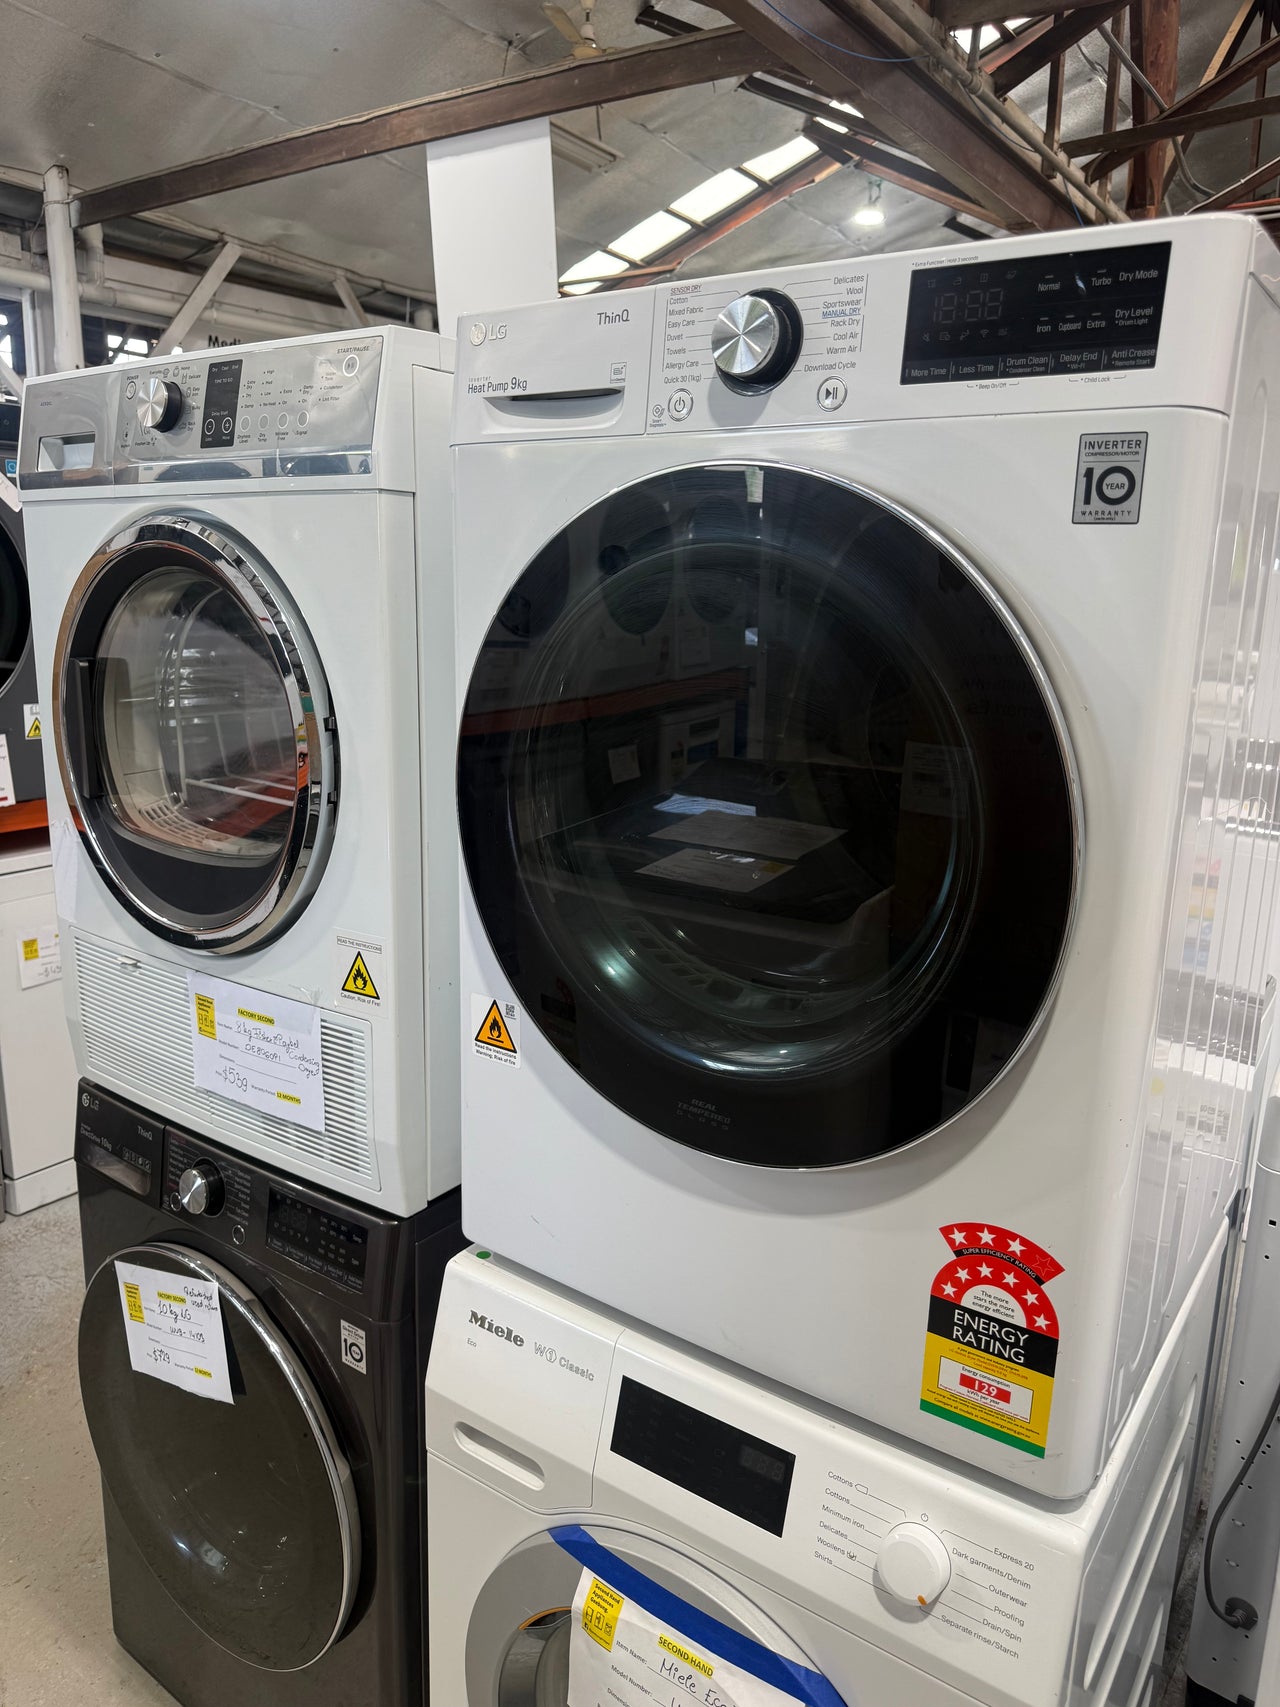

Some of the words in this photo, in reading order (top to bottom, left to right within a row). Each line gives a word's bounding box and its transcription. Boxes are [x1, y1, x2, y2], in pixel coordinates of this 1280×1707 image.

[833, 275, 864, 286] Delicates
[1038, 282, 1060, 292] Normal
[1092, 277, 1112, 287] Turbo
[1119, 272, 1134, 283] Dry
[1135, 270, 1158, 280] Mode
[670, 286, 690, 296] SENSOR
[691, 284, 702, 294] DRY
[846, 286, 864, 296] Wool
[669, 308, 686, 317] Mixed
[686, 306, 704, 314] Fabric
[822, 300, 862, 311] Sportswear
[822, 309, 847, 318] MANUAL
[848, 308, 861, 316] DRY
[597, 309, 630, 326] ThinQ
[668, 322, 680, 331] Easy
[681, 319, 696, 327] Care
[830, 320, 847, 328] Rack
[848, 318, 860, 328] Dry
[1036, 325, 1051, 333] Iron
[1058, 322, 1082, 332] Cupboard
[1087, 320, 1106, 328] Extra
[1116, 309, 1130, 320] Dry
[1132, 306, 1154, 318] Level
[1134, 318, 1148, 326] Light
[489, 324, 508, 341] LG
[667, 334, 684, 342] Duvet
[833, 334, 848, 342] Cool
[849, 331, 860, 340] Air
[337, 346, 370, 354] START/PAUSE
[826, 346, 848, 356] Warm
[848, 345, 858, 354] Air
[1006, 357, 1026, 367] Drum
[1028, 356, 1048, 365] Clean
[1060, 353, 1081, 364] Delay
[1082, 352, 1098, 361] End
[1112, 350, 1128, 359] Anti
[1130, 348, 1156, 358] Crease
[665, 360, 686, 371] Allergy
[686, 358, 700, 366] Care
[804, 362, 836, 373] Download
[838, 360, 856, 371] Cycle
[912, 368, 929, 378] More
[930, 368, 946, 376] Time
[960, 366, 976, 374] Less
[978, 364, 994, 373] Time
[468, 382, 486, 394] Heat
[487, 380, 509, 393] Pump
[511, 377, 528, 392] 9kg
[664, 376, 679, 385] Quick
[688, 374, 702, 383] (1kg)
[1083, 439, 1142, 450] INVERTER
[1083, 466, 1136, 506] 10
[238, 1008, 257, 1020] FACTORY
[257, 1014, 275, 1024] SECOND
[493, 1047, 517, 1060] instructions
[90, 1098, 100, 1110] LG
[282, 1093, 302, 1104] MONTHS
[138, 1125, 152, 1140] ThinQ
[962, 1247, 980, 1255] SUPER
[980, 1248, 1014, 1263] EFFICIENCY
[1014, 1260, 1036, 1279] RATING
[158, 1292, 172, 1300] FACTORY
[172, 1295, 186, 1304] SECOND
[974, 1294, 987, 1304] stars
[988, 1300, 998, 1308] the
[998, 1304, 1014, 1314] more
[980, 1290, 992, 1298] The
[993, 1296, 1009, 1305] more
[972, 1300, 991, 1312] energy
[992, 1307, 1015, 1320] efficient
[469, 1310, 525, 1348] Miele
[954, 1309, 1029, 1347] ENERGY
[467, 1338, 477, 1348] Eco
[953, 1326, 1025, 1364] RATING
[558, 1356, 595, 1382] Classic
[962, 1366, 978, 1377] Energy
[978, 1371, 1010, 1389] consumption
[974, 1380, 998, 1397] 129
[979, 1394, 988, 1403] per
[989, 1398, 1000, 1406] year
[828, 1471, 854, 1488] Cottons
[825, 1488, 850, 1505] Cottons
[822, 1504, 852, 1523] Minimum
[852, 1518, 866, 1530] iron
[820, 1520, 848, 1540] Delicates
[816, 1536, 846, 1556] Woollens
[814, 1550, 833, 1566] Shirts
[994, 1548, 1022, 1568] Express
[1024, 1560, 1035, 1572] 20
[952, 1547, 969, 1561] Dark
[970, 1556, 1032, 1590] garments/Denim
[988, 1584, 1028, 1608] Outerwear
[994, 1605, 1025, 1628] Proofing
[940, 1614, 973, 1636] Separate
[973, 1631, 1020, 1660] rinse/Starch
[982, 1618, 1022, 1644] Drain/Spin
[616, 1640, 630, 1652] Item
[630, 1648, 647, 1665] Name:
[659, 1636, 689, 1661] SECOND
[690, 1656, 714, 1678] HAND
[610, 1664, 629, 1681] Model
[629, 1677, 653, 1697] Number:
[660, 1658, 696, 1694] Miele
